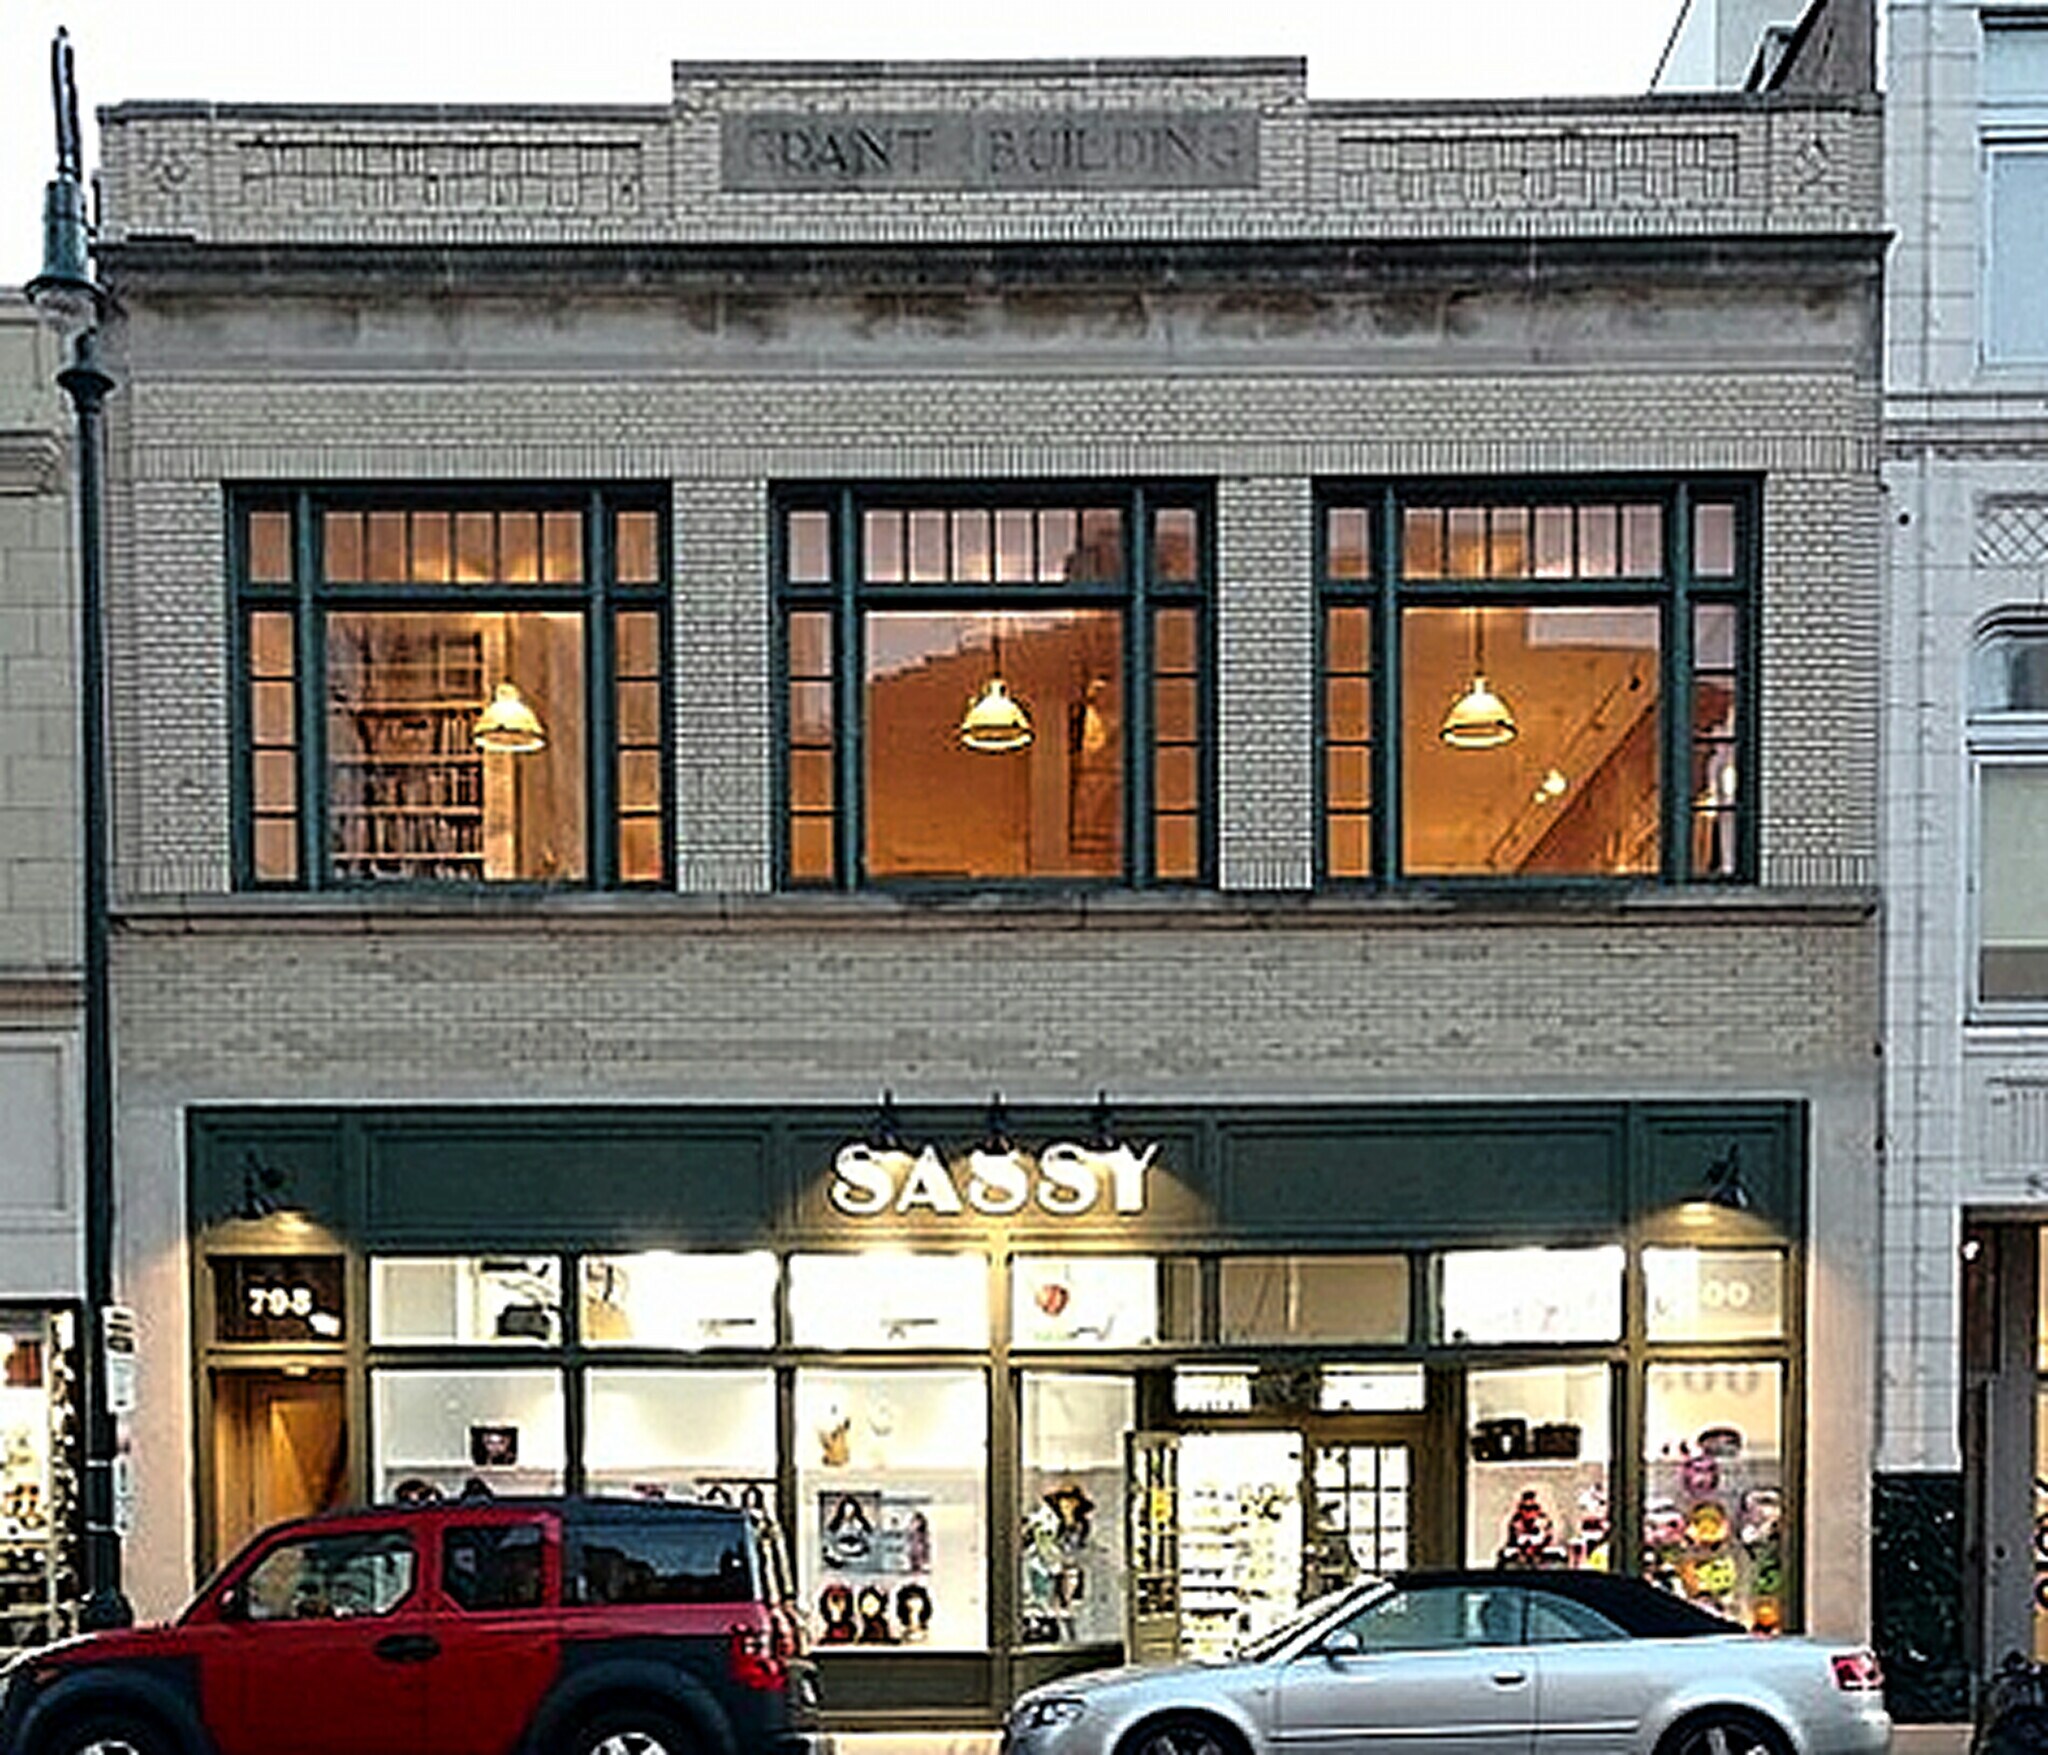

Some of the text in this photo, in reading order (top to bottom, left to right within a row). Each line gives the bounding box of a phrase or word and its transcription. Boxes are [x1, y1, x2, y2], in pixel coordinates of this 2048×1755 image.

[750, 125, 1240, 174] GRANT BUILDING
[831, 1143, 1161, 1216] SASSY
